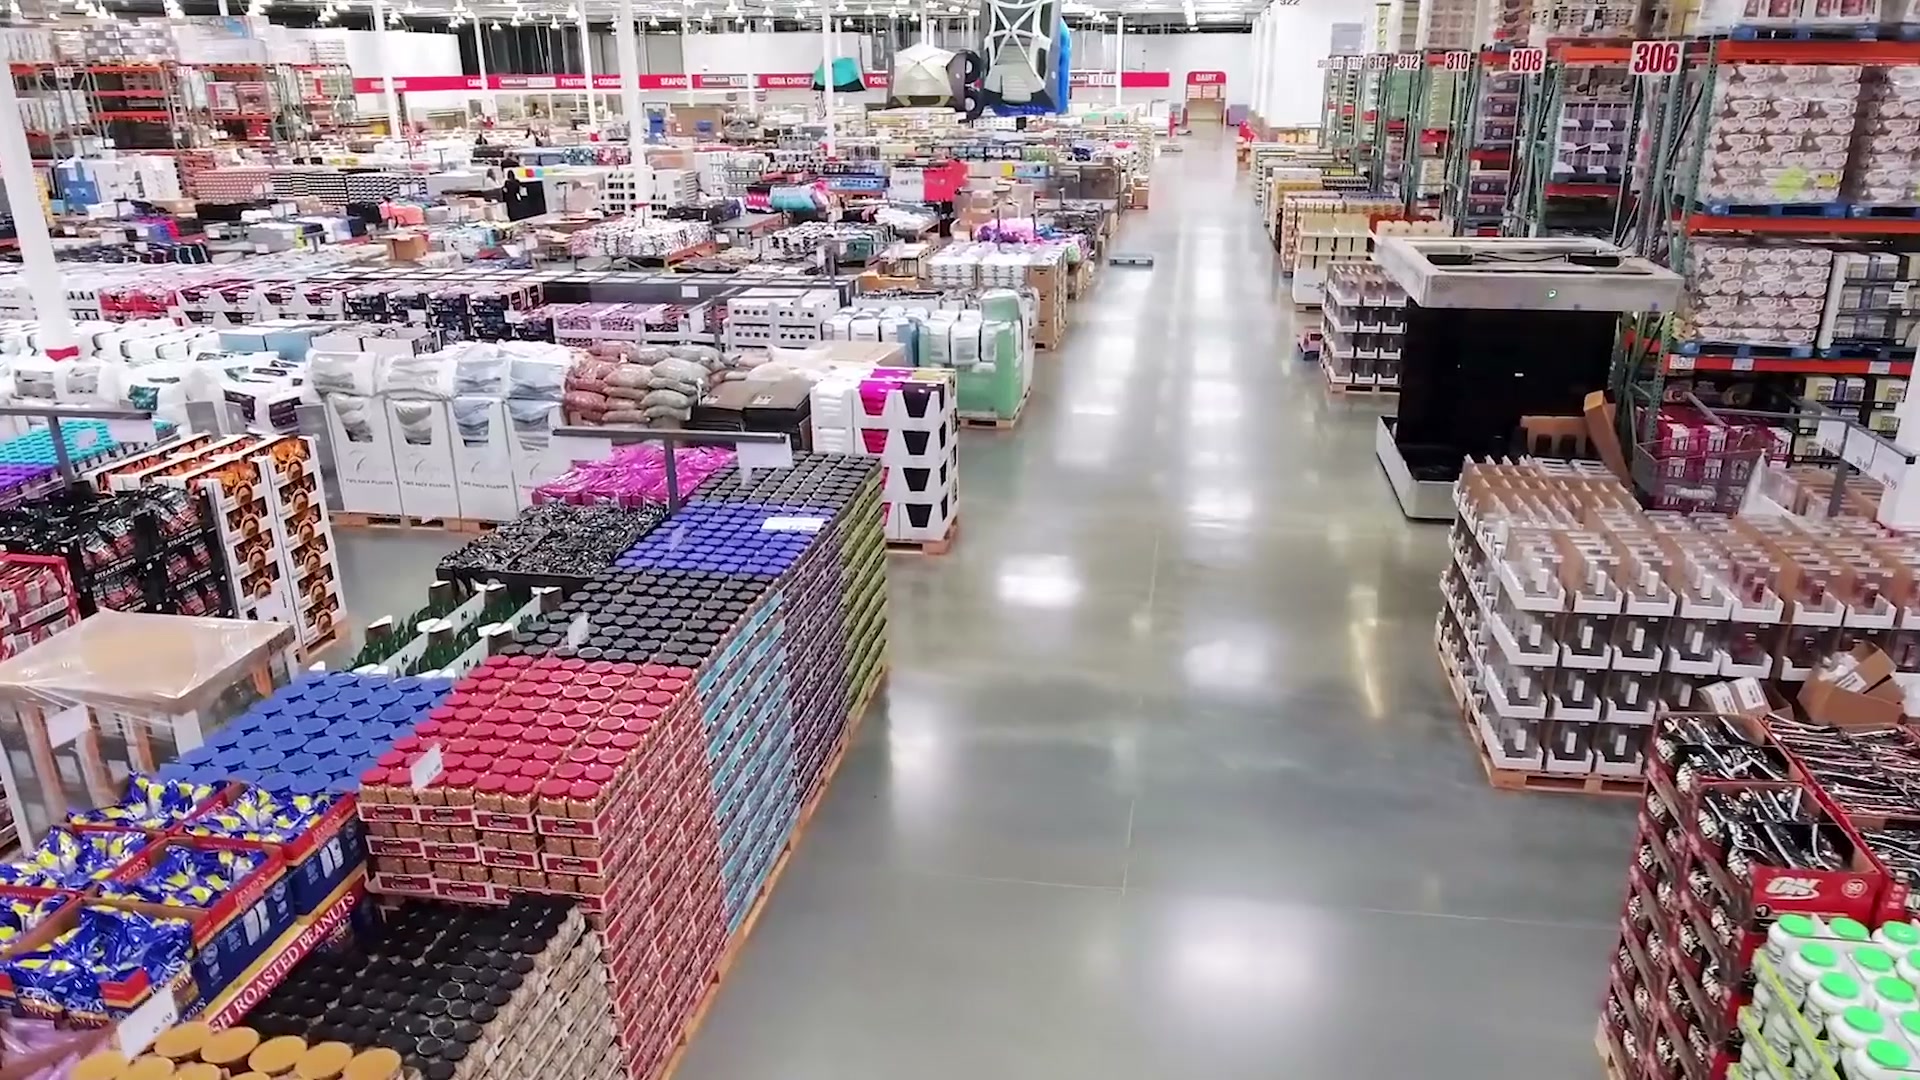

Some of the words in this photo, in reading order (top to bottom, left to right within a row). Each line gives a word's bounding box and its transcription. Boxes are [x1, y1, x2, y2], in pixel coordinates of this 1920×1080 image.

[1399, 55, 1418, 69] 312
[1446, 53, 1468, 70] 310
[1511, 49, 1543, 72] 308
[1634, 43, 1679, 73] 306
[660, 77, 687, 86] SEAFOO
[1195, 73, 1217, 82] DAIRY
[233, 946, 301, 1015] ROASTED
[299, 891, 356, 952] PEANUTS
